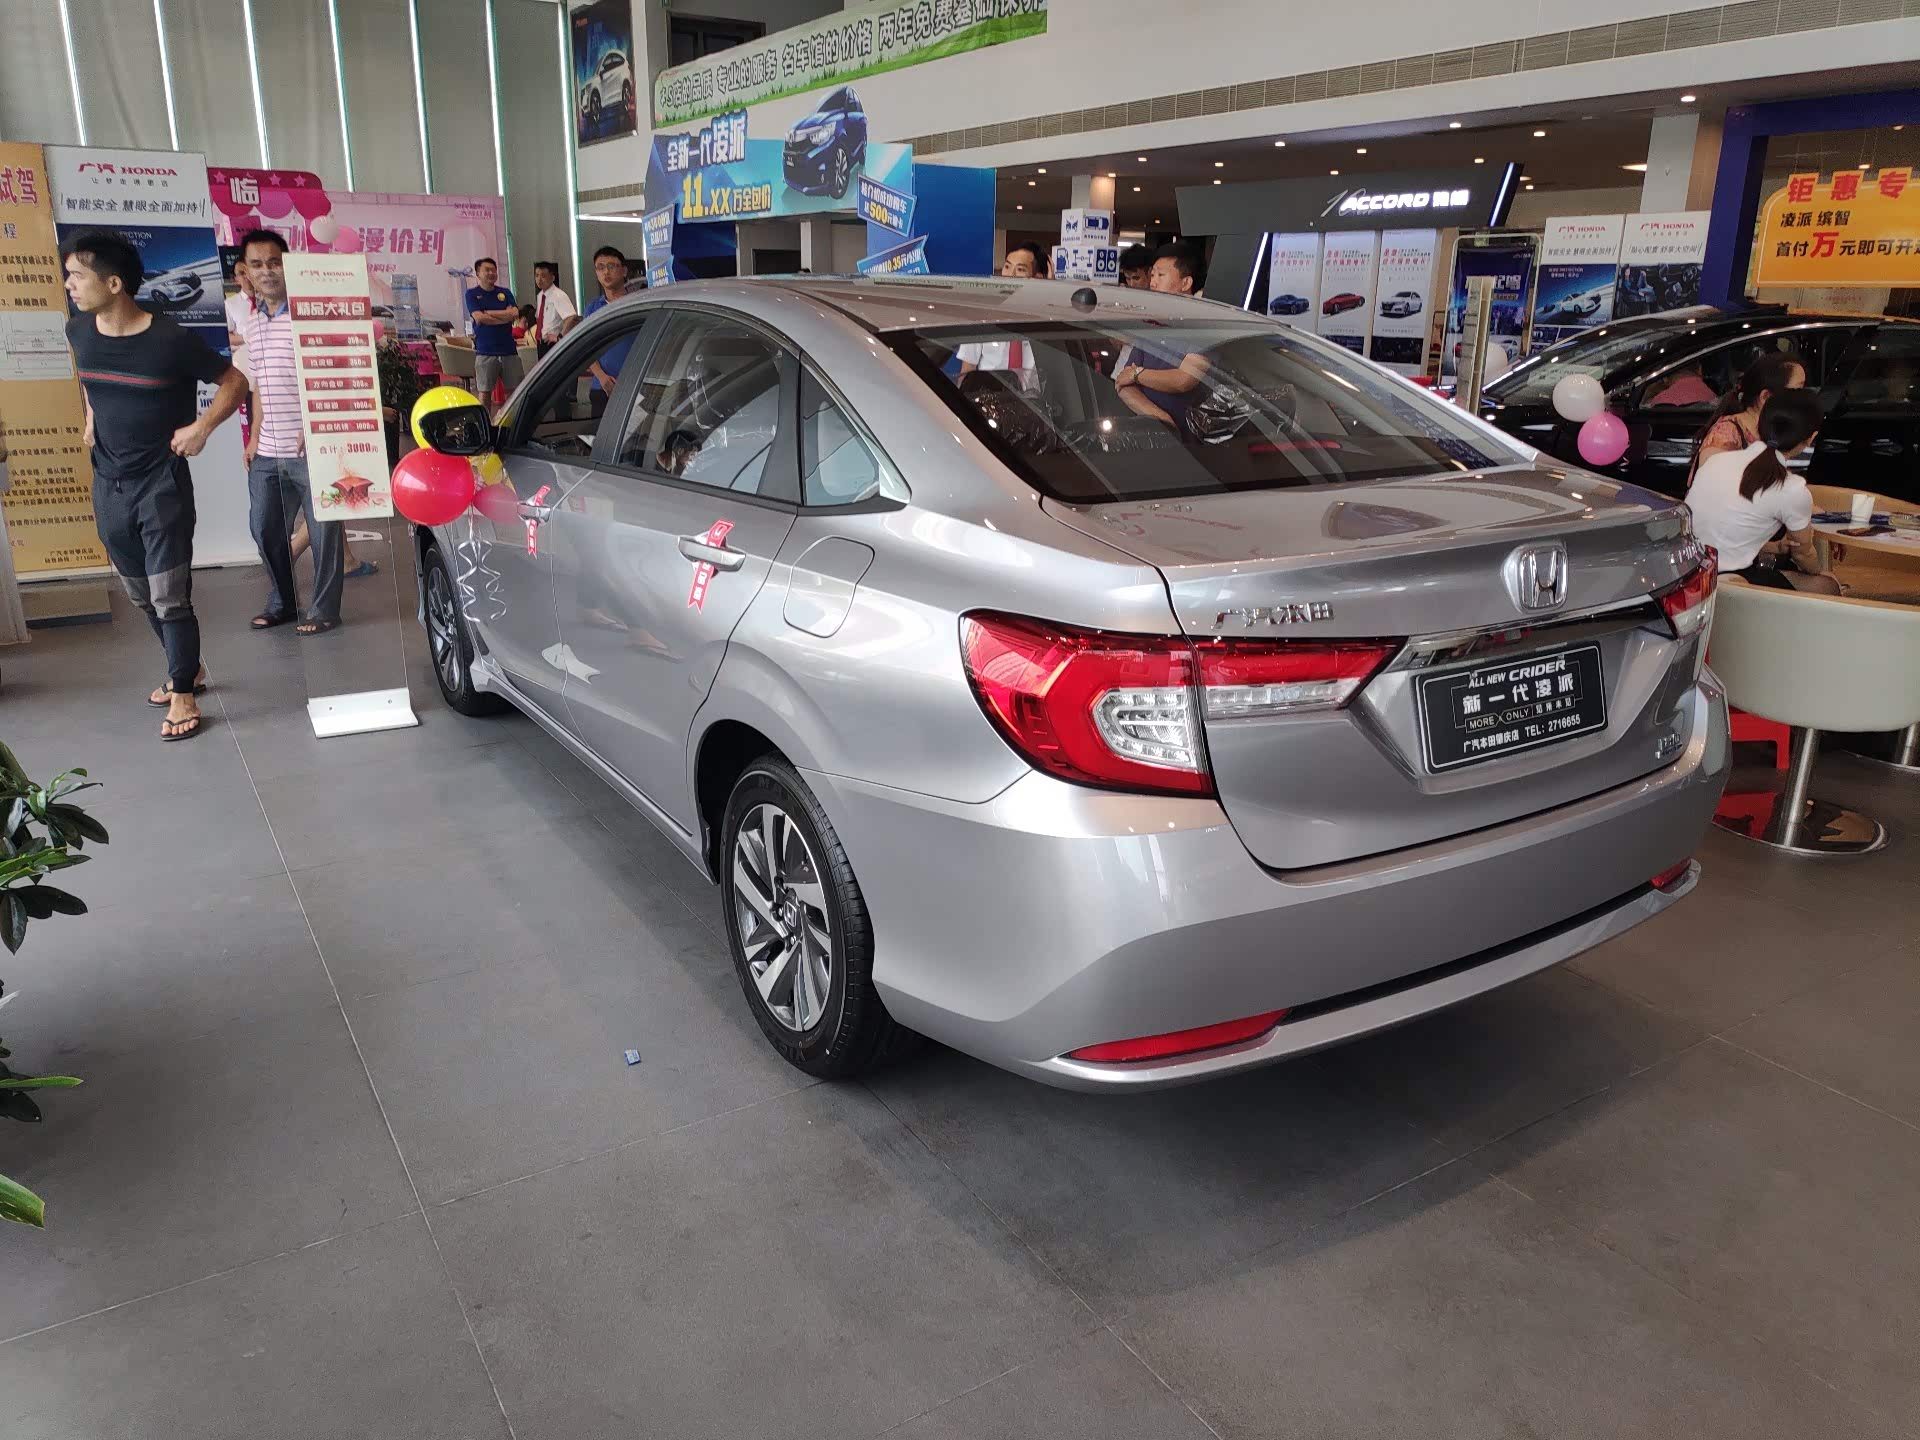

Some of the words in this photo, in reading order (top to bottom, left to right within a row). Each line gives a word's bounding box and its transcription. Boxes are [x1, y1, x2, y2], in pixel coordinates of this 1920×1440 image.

[717, 50, 777, 95] 专业的服务
[781, 20, 872, 78] 名车馆的价格
[667, 114, 746, 172] 全新一代凌派
[78, 163, 115, 174] 广汽
[121, 166, 178, 176] HONDA
[230, 177, 260, 206] 临
[1340, 192, 1431, 212] ACCORD
[66, 197, 118, 213] 智能安全
[122, 199, 199, 215] 慧眼全面加持
[1662, 222, 1695, 230] HONDA
[1780, 211, 1813, 228] 凌派
[1816, 210, 1851, 227] 缤智
[296, 302, 365, 317] 精品大礼包
[1468, 678, 1486, 689] ALL
[1487, 671, 1507, 685] NEW
[1508, 659, 1566, 683] CRIDER
[1462, 672, 1575, 715] 新一代凌派
[1469, 716, 1496, 730] MORE
[1505, 707, 1530, 722] ONLY
[1463, 729, 1520, 754] 广汽本田肇庆店
[1548, 713, 1582, 732] 2716655
